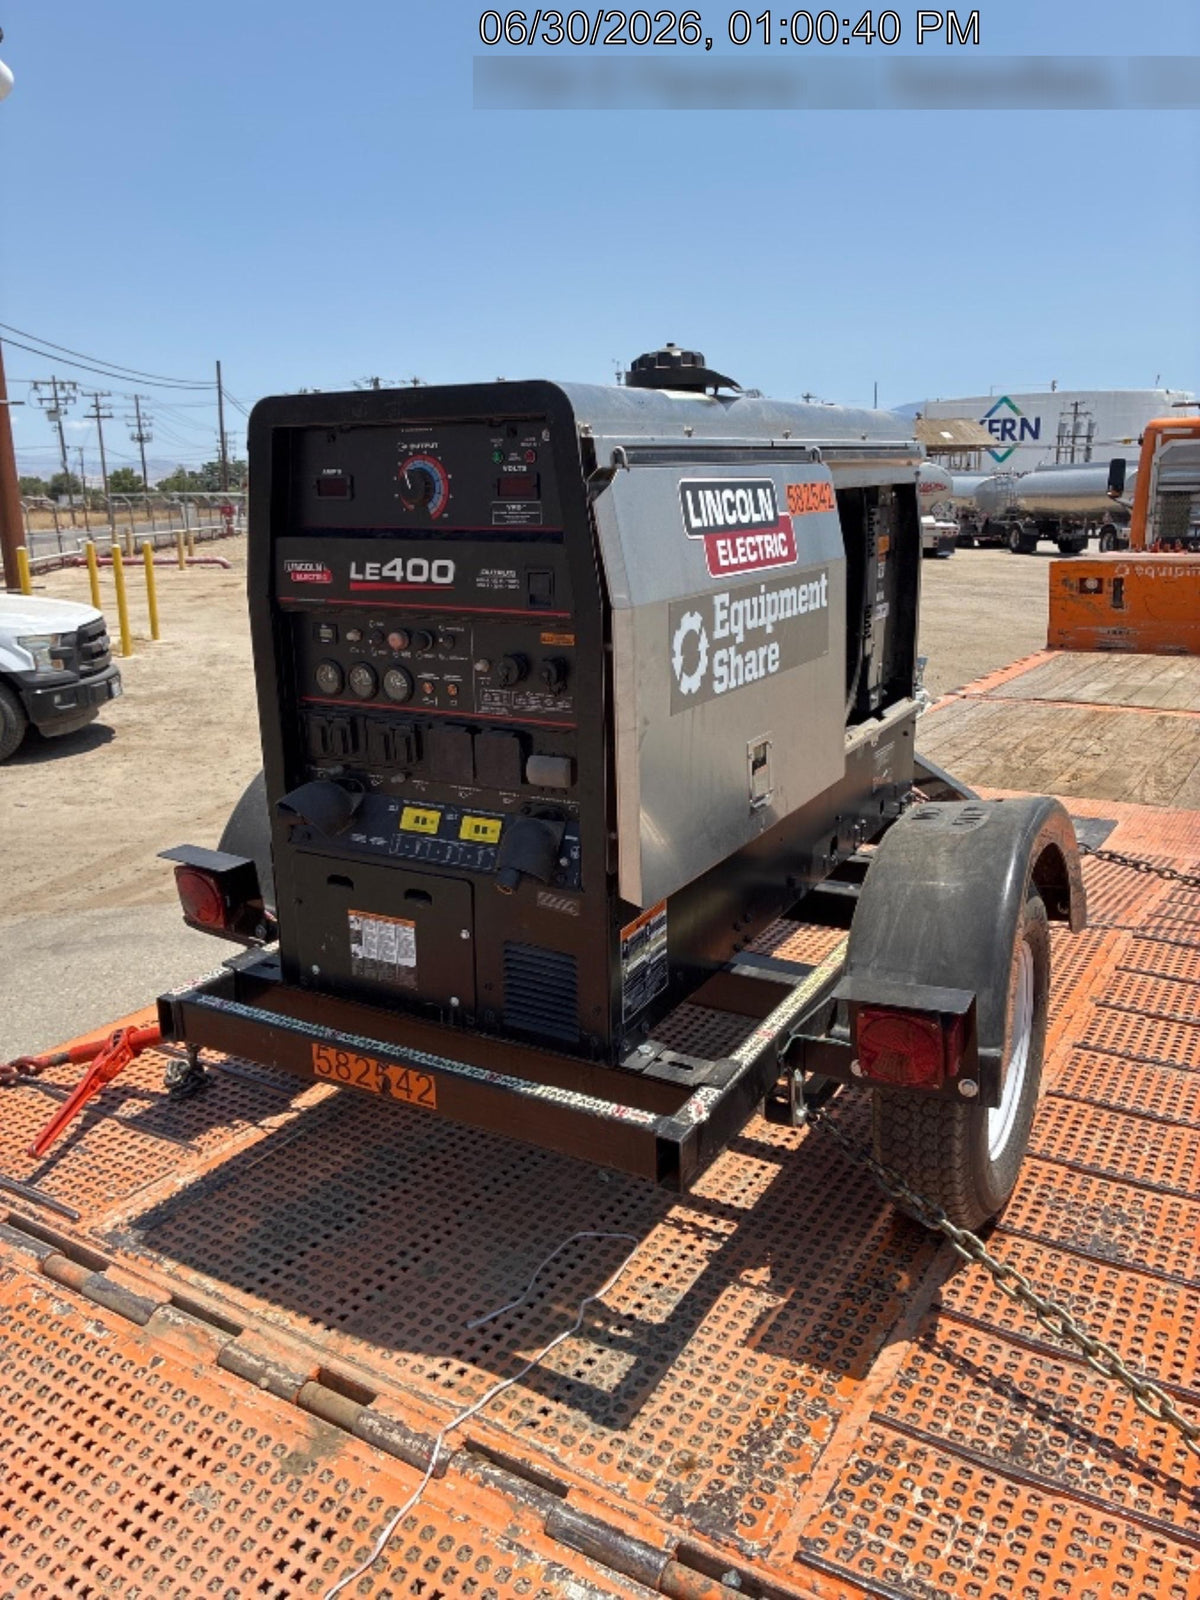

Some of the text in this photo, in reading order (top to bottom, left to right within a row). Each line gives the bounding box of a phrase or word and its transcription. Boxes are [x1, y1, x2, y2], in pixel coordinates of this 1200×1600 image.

[685, 487, 775, 529] LINCOLN
[787, 482, 835, 515] 582542
[716, 532, 789, 567] ELECTRIC
[349, 557, 456, 585] LE400
[712, 572, 829, 644] Equipment
[712, 640, 780, 695] Share
[316, 1046, 435, 1106] 582542
